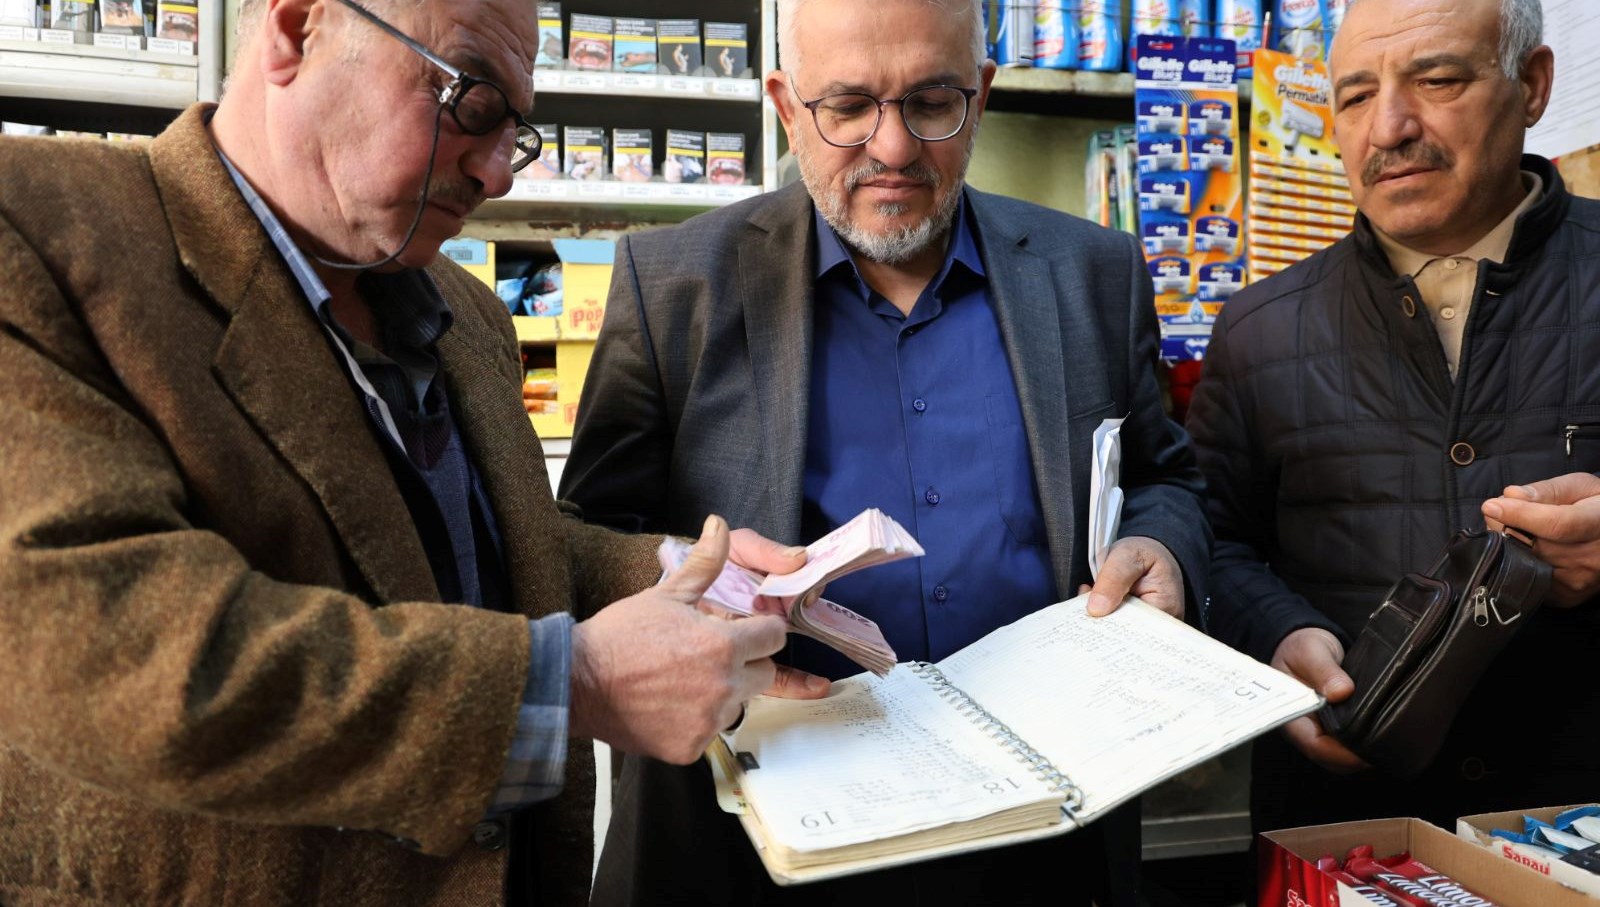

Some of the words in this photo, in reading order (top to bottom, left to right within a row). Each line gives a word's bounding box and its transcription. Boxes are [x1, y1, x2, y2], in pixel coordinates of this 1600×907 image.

[1137, 56, 1185, 72] Gillette
[1187, 58, 1235, 74] Gillette
[1278, 83, 1330, 106] Permatik
[1234, 680, 1272, 701] 15
[982, 776, 1021, 796] 18
[800, 810, 837, 830] 19
